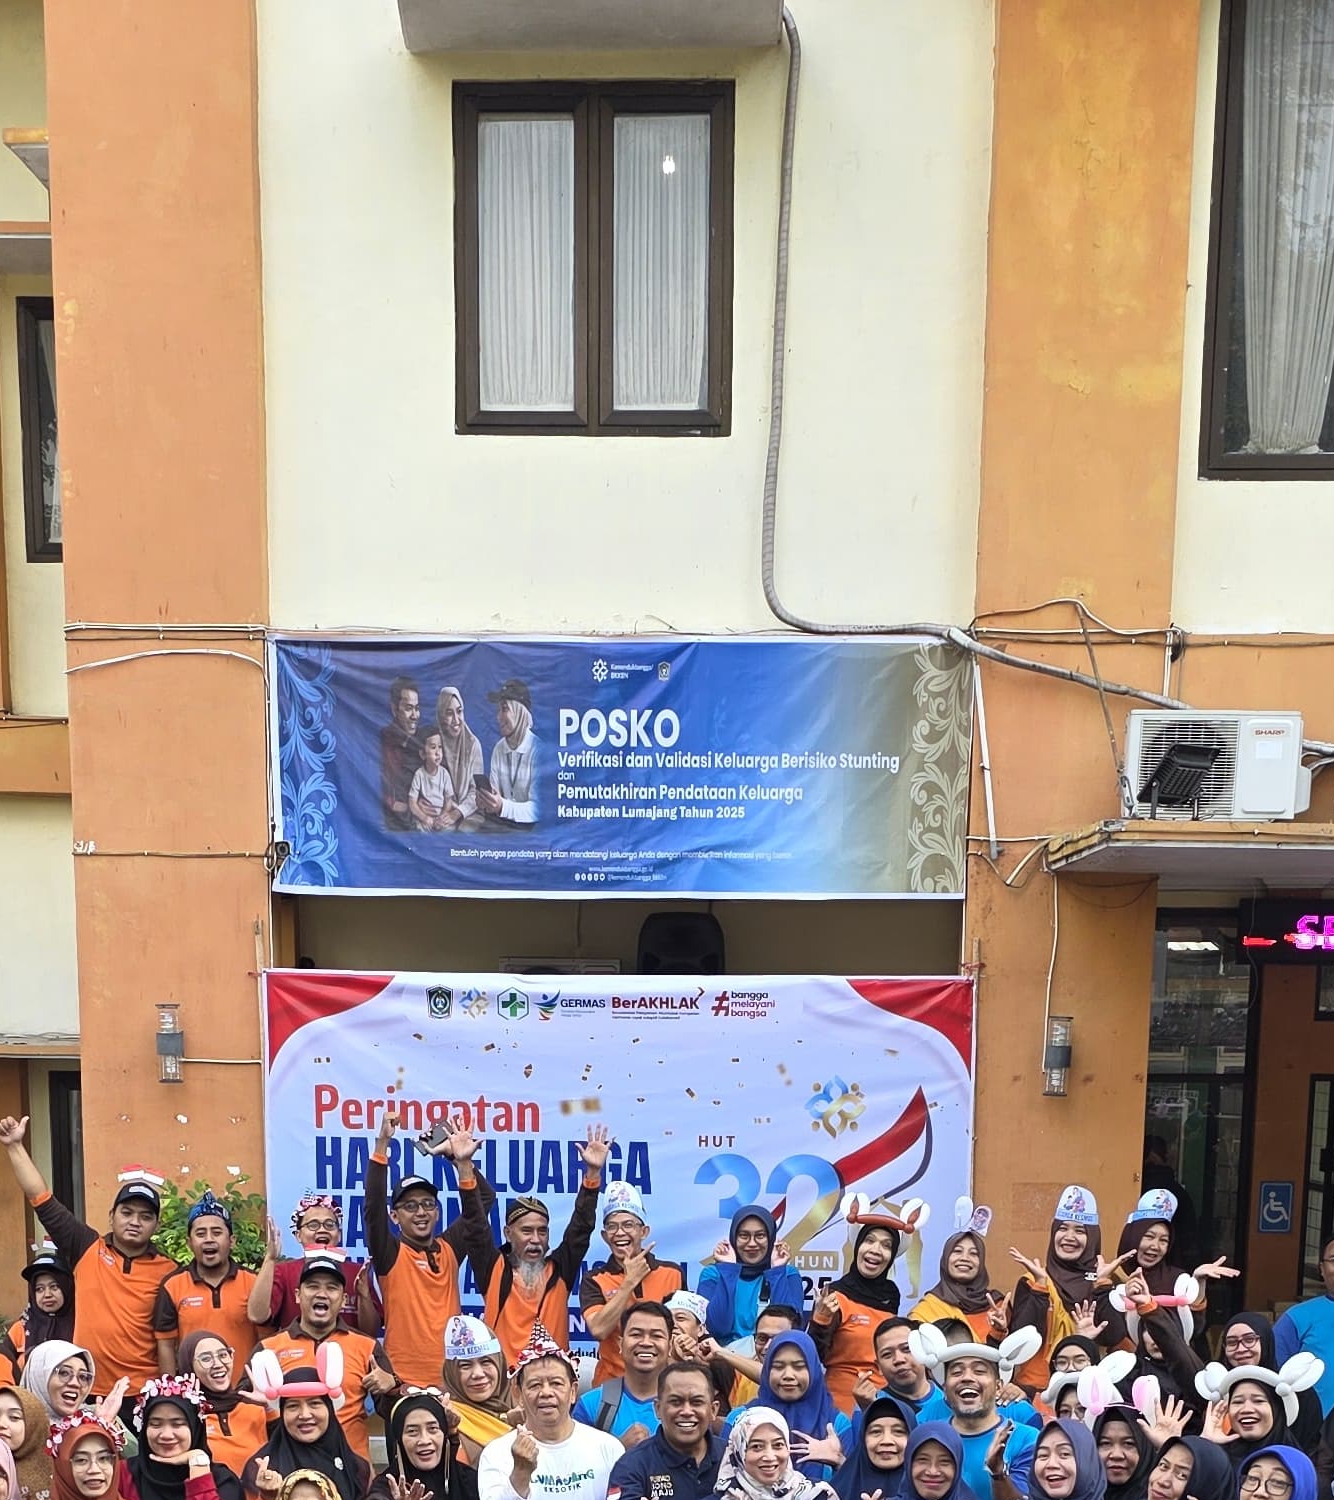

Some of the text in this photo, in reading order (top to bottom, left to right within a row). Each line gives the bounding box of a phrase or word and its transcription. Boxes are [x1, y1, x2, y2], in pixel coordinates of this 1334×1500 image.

[559, 708, 680, 748] POSKO
[558, 751, 900, 774] Verifikasi dan Validasi Keluarga Berisiko Stunting
[557, 770, 575, 781] dan
[558, 783, 804, 804] Pemutakhiran Pendataan Keluarga
[558, 805, 745, 820] Kabupaten Lumajang Tahun 2025
[612, 996, 699, 1009] BerAKHLAK
[731, 991, 769, 1001] bangga
[560, 998, 606, 1009] GERMAS
[731, 1000, 775, 1010] melayani
[731, 1009, 767, 1019] bangsa
[314, 1084, 540, 1133] Peringatan
[698, 1135, 736, 1148] HUT
[794, 1255, 835, 1269] HUN
[544, 1482, 581, 1493] EKSOTIK
